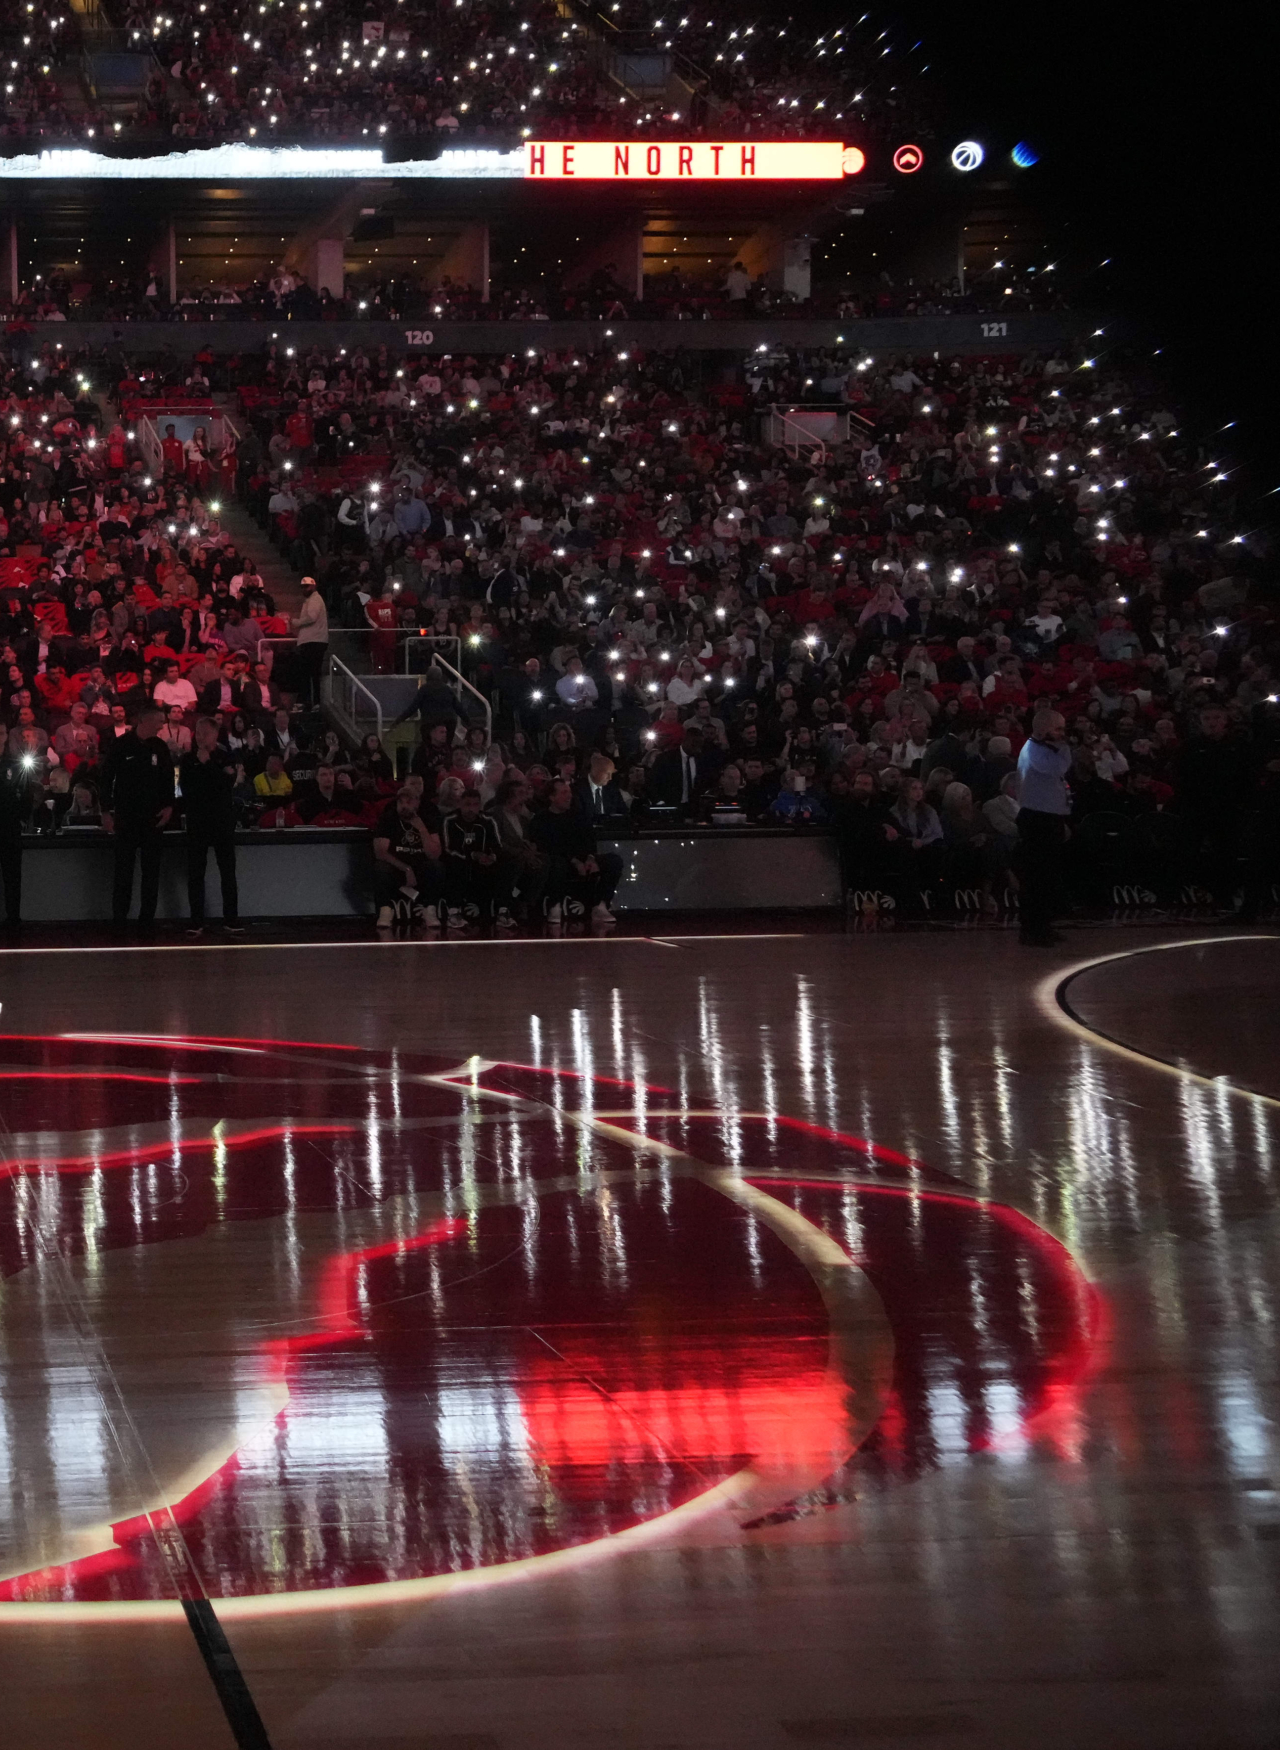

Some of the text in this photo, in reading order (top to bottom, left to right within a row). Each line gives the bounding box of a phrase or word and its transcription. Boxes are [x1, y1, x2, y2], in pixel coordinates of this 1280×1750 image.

[615, 145, 756, 175] NORTH
[980, 322, 1007, 337] 121
[405, 330, 434, 345] 120
